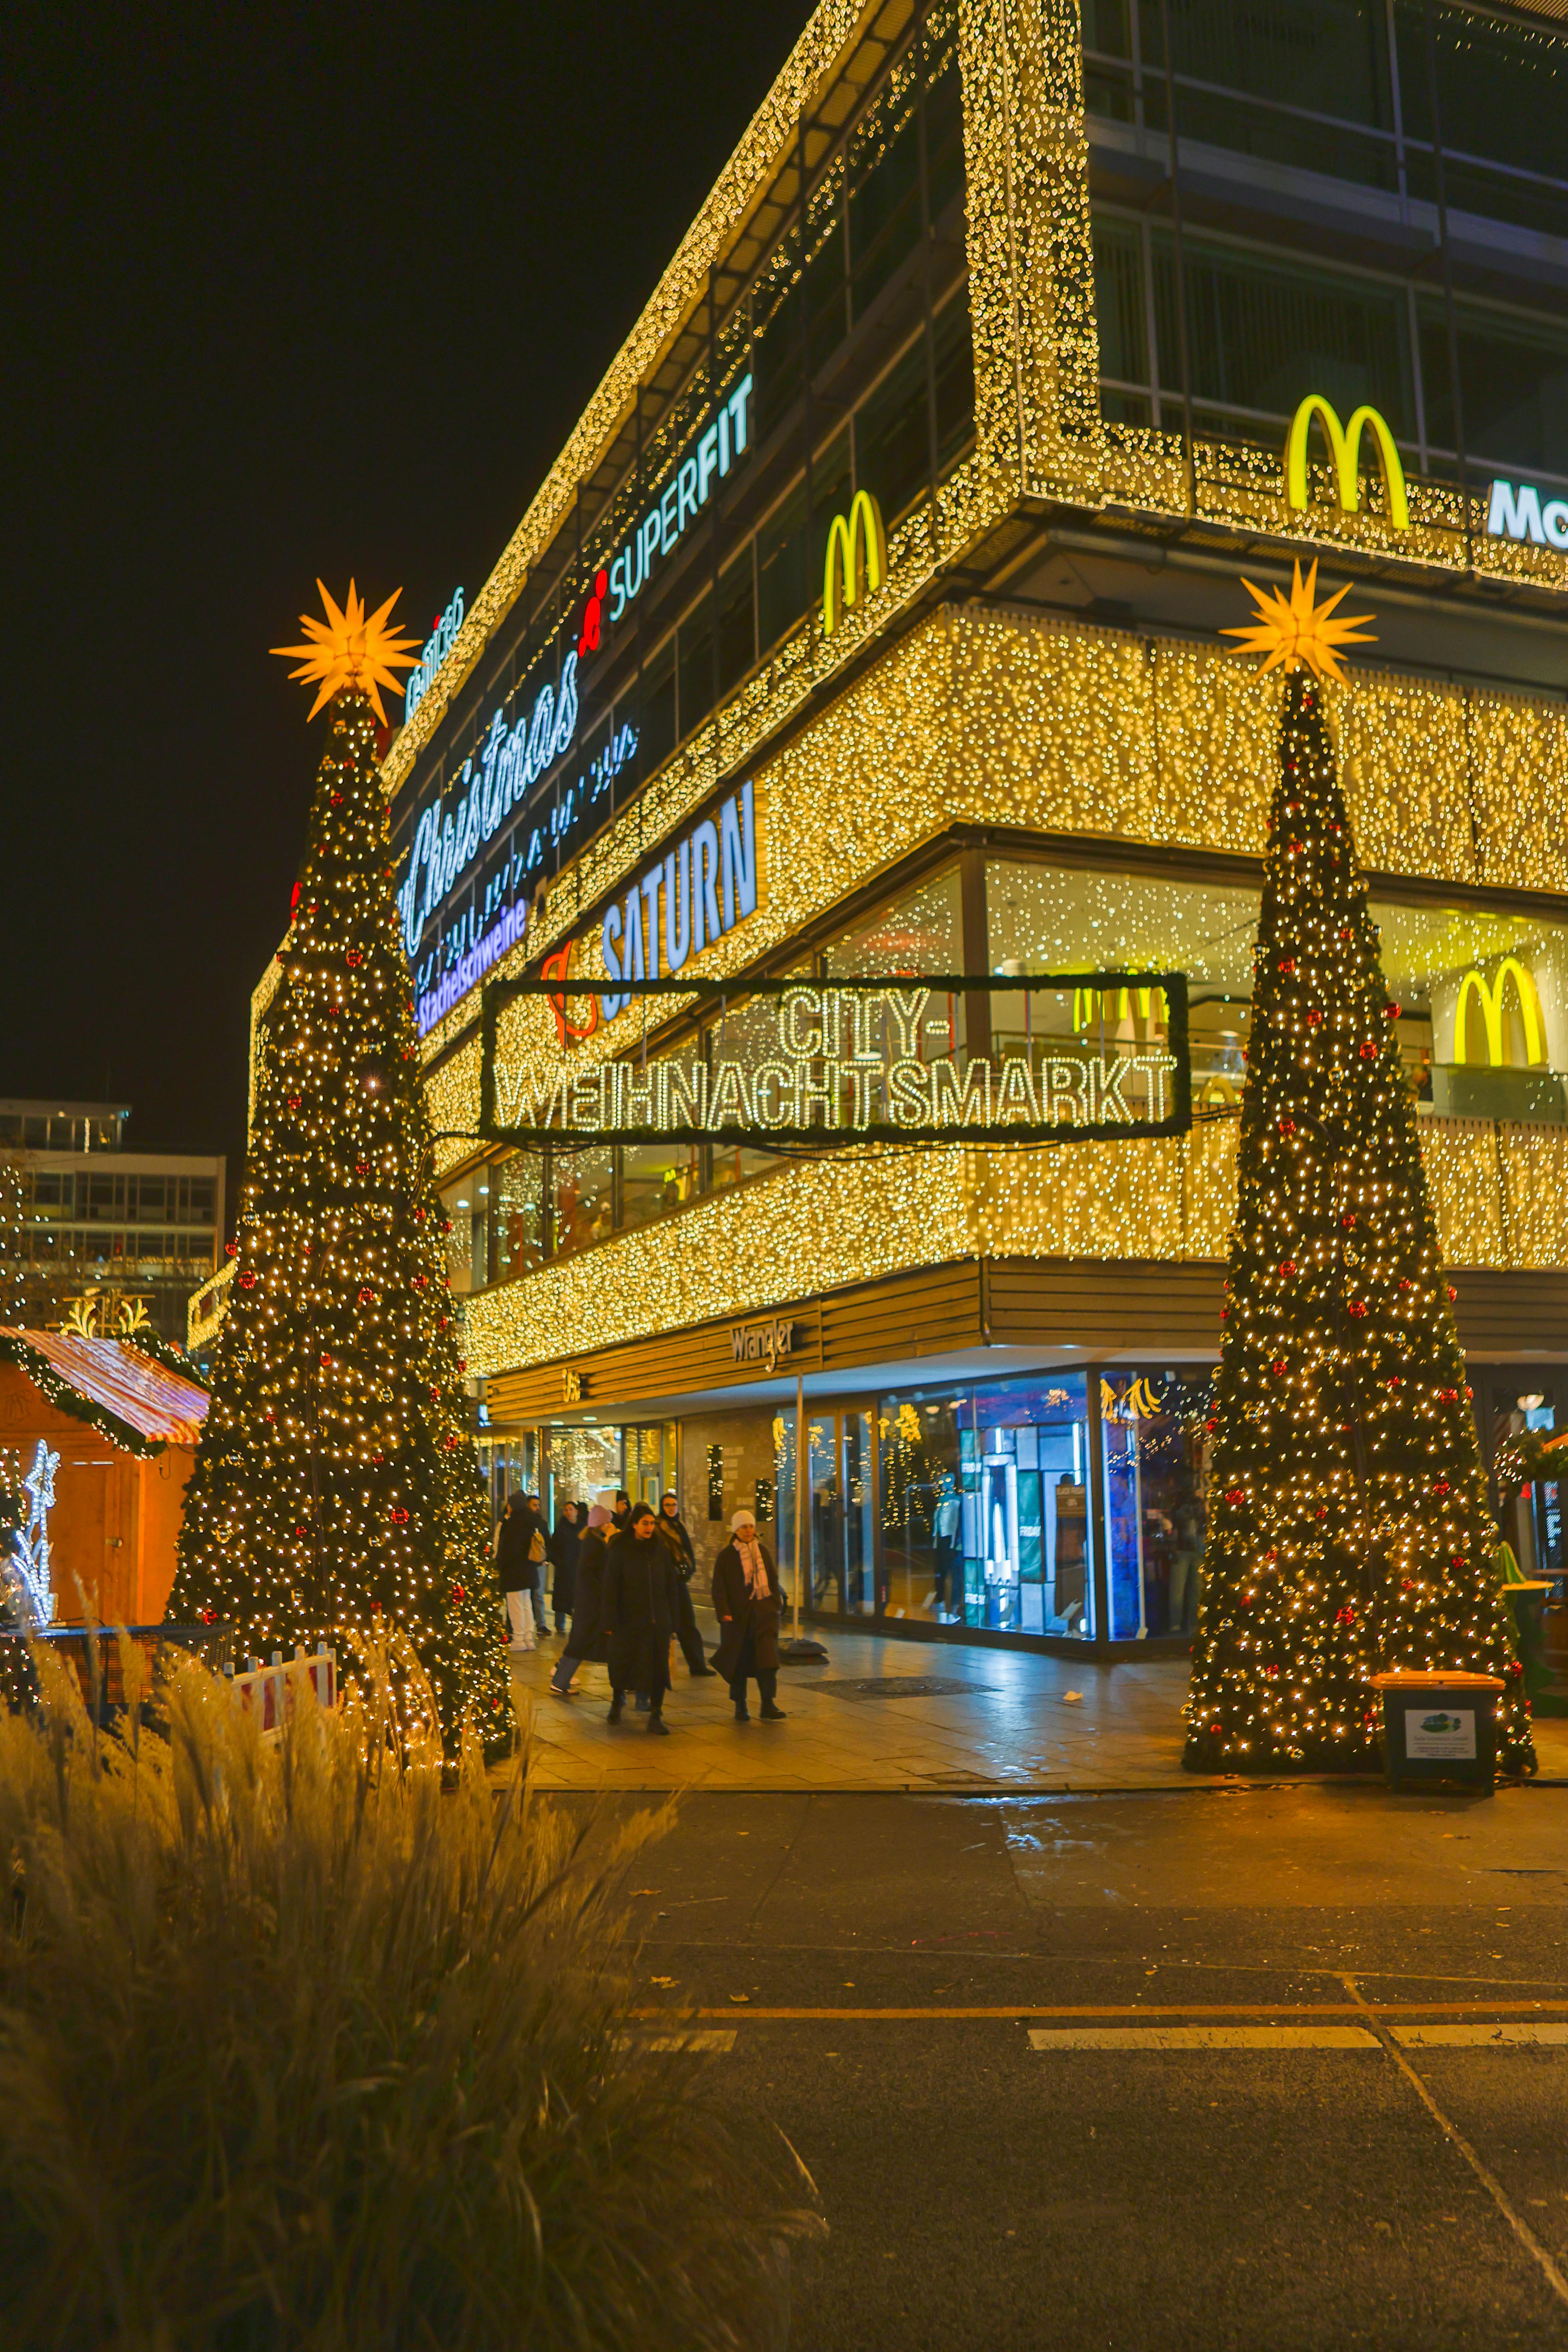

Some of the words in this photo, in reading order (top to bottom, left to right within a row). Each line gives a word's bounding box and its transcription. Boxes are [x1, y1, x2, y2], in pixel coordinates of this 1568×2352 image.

[609, 374, 753, 622] SUPERFIT
[401, 648, 579, 958] Christmas
[601, 779, 758, 1021] SATURN
[418, 898, 526, 1038] Stachelschweine
[779, 985, 950, 1059] CITY-
[492, 1055, 1178, 1133] WEIHNACHTSMARKT
[730, 1319, 793, 1372] Wrangler
[1019, 1525, 1041, 1537] FRIDAY
